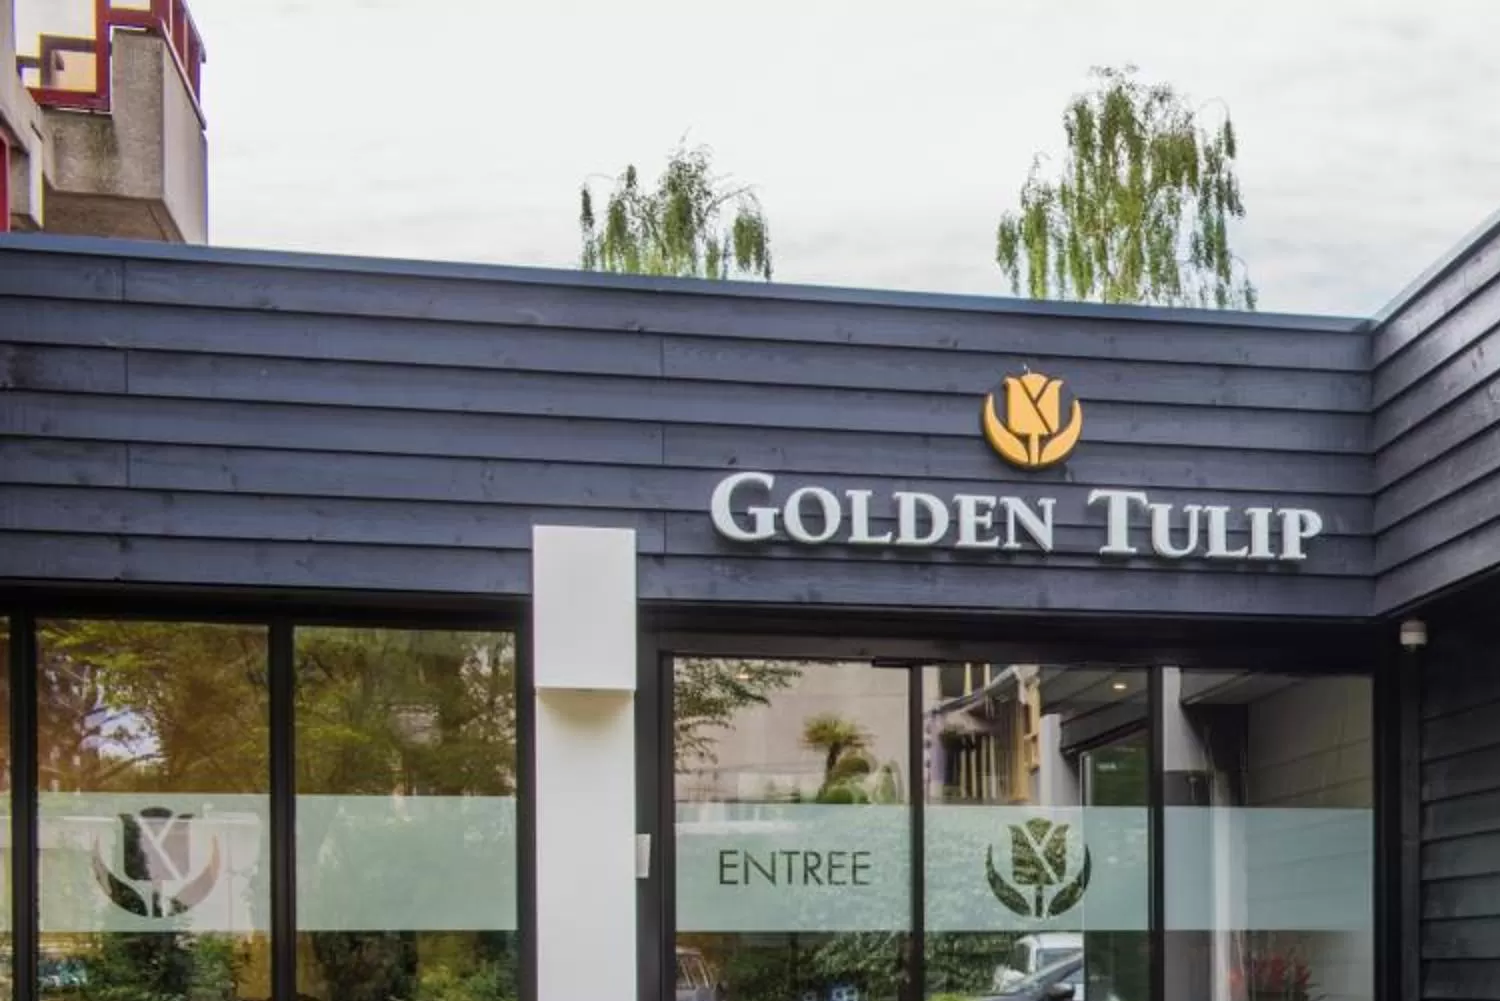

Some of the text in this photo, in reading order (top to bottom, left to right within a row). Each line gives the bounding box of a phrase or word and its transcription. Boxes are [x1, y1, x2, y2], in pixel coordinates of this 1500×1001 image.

[710, 472, 1323, 561] GOLDEN TULIP
[718, 849, 872, 886] ENTREE
